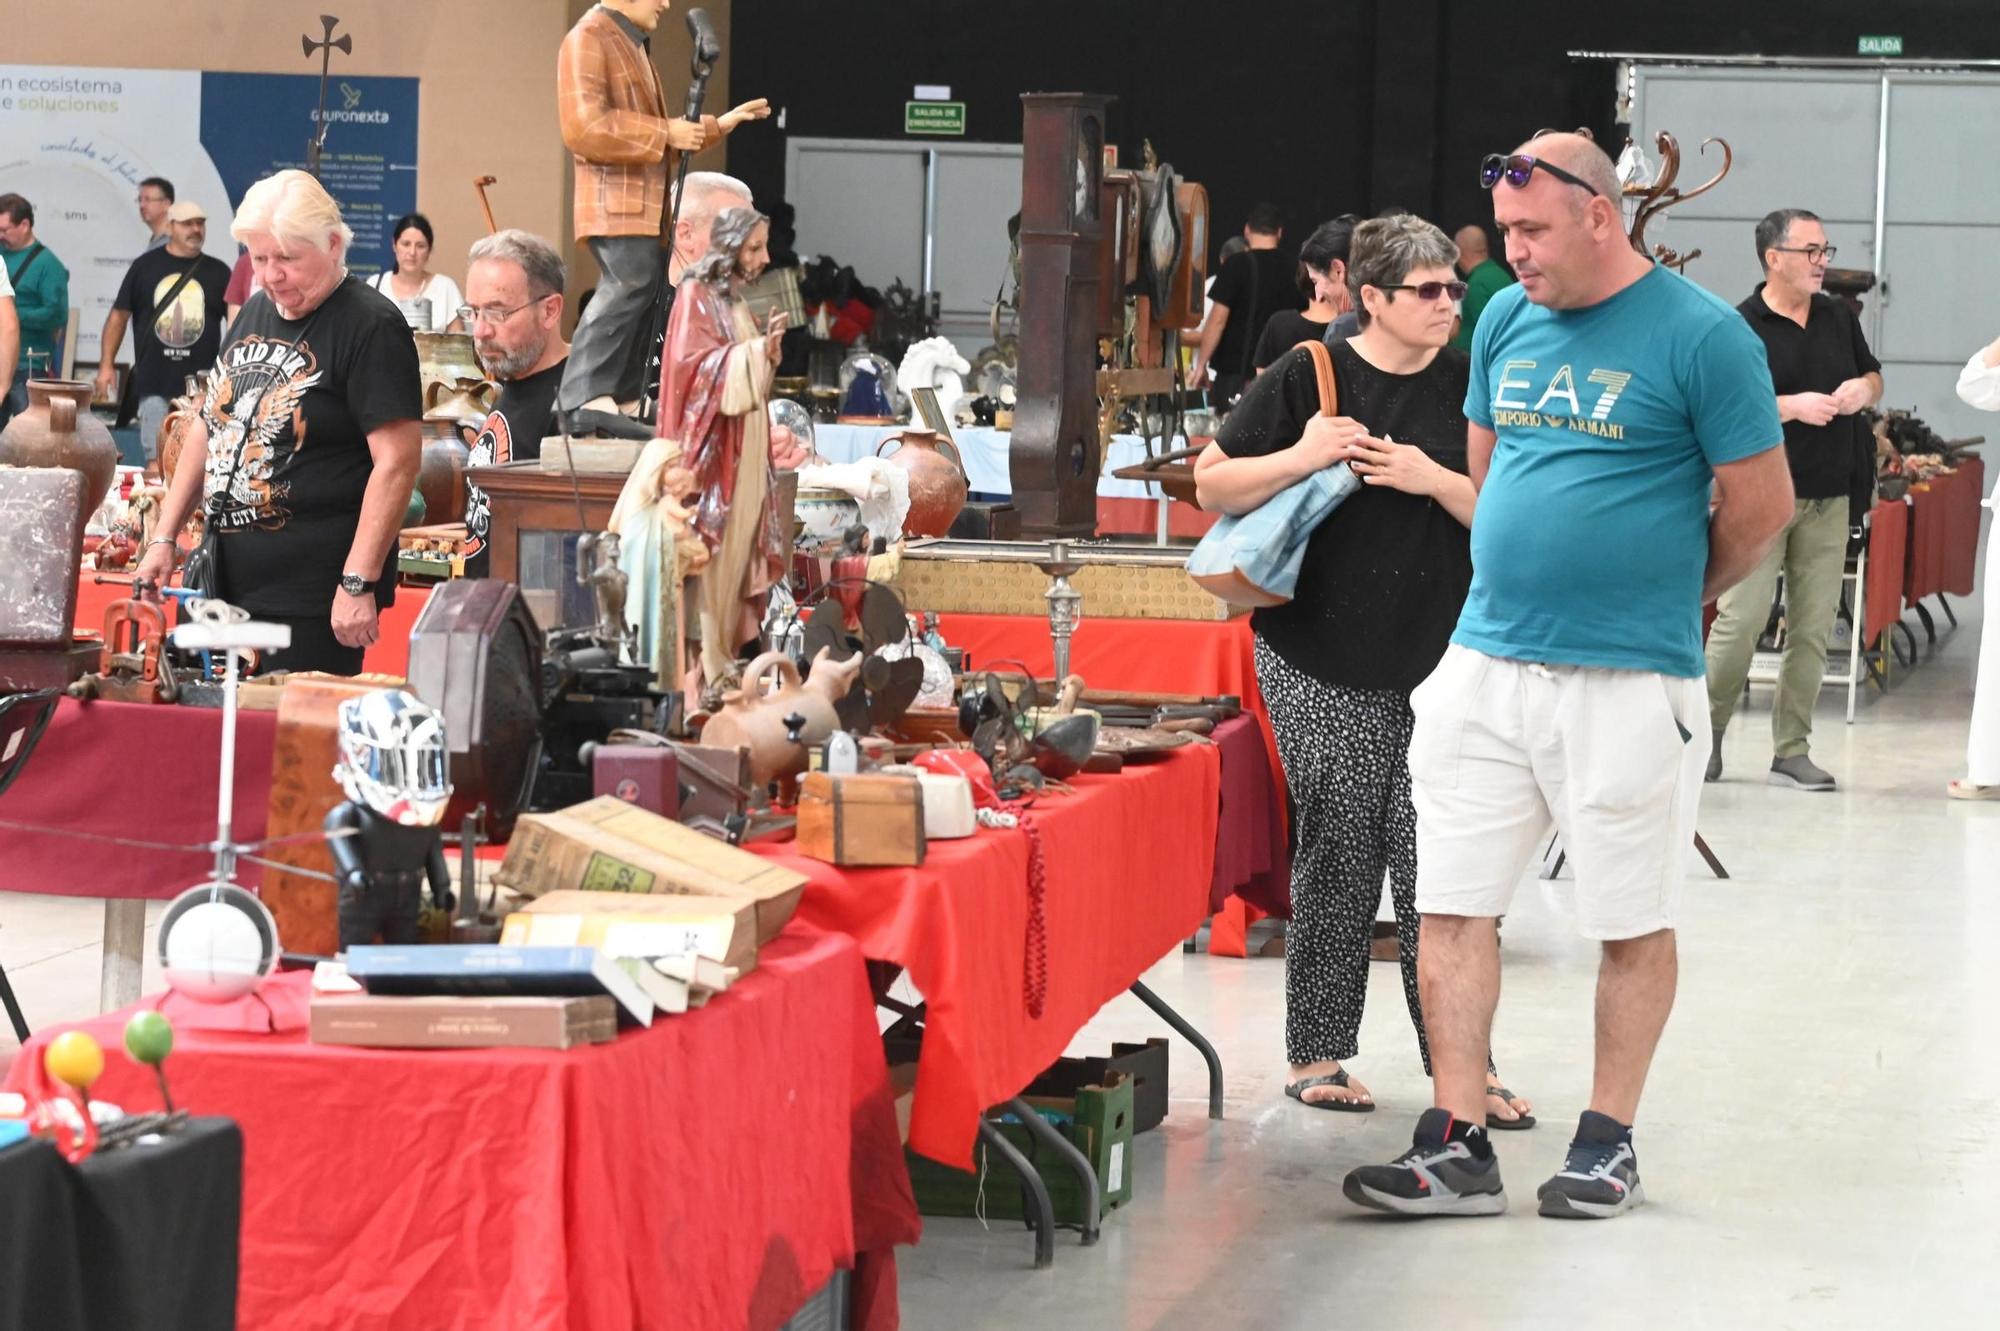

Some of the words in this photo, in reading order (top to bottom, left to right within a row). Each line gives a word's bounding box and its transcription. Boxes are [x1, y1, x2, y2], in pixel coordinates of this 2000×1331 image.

[1859, 38, 1902, 53] SALIDA
[18, 77, 123, 94] ecosistema
[18, 97, 119, 113] soluciones
[913, 108, 943, 117] SALIDA
[944, 109, 957, 118] DE
[908, 119, 962, 128] EMERGENCIA
[65, 210, 88, 221] sms
[231, 343, 269, 368] KID
[1493, 359, 1632, 420] EA7
[1494, 410, 1542, 428] EMPORIO
[1568, 417, 1624, 440] ARMANI
[230, 506, 258, 526] CITY
